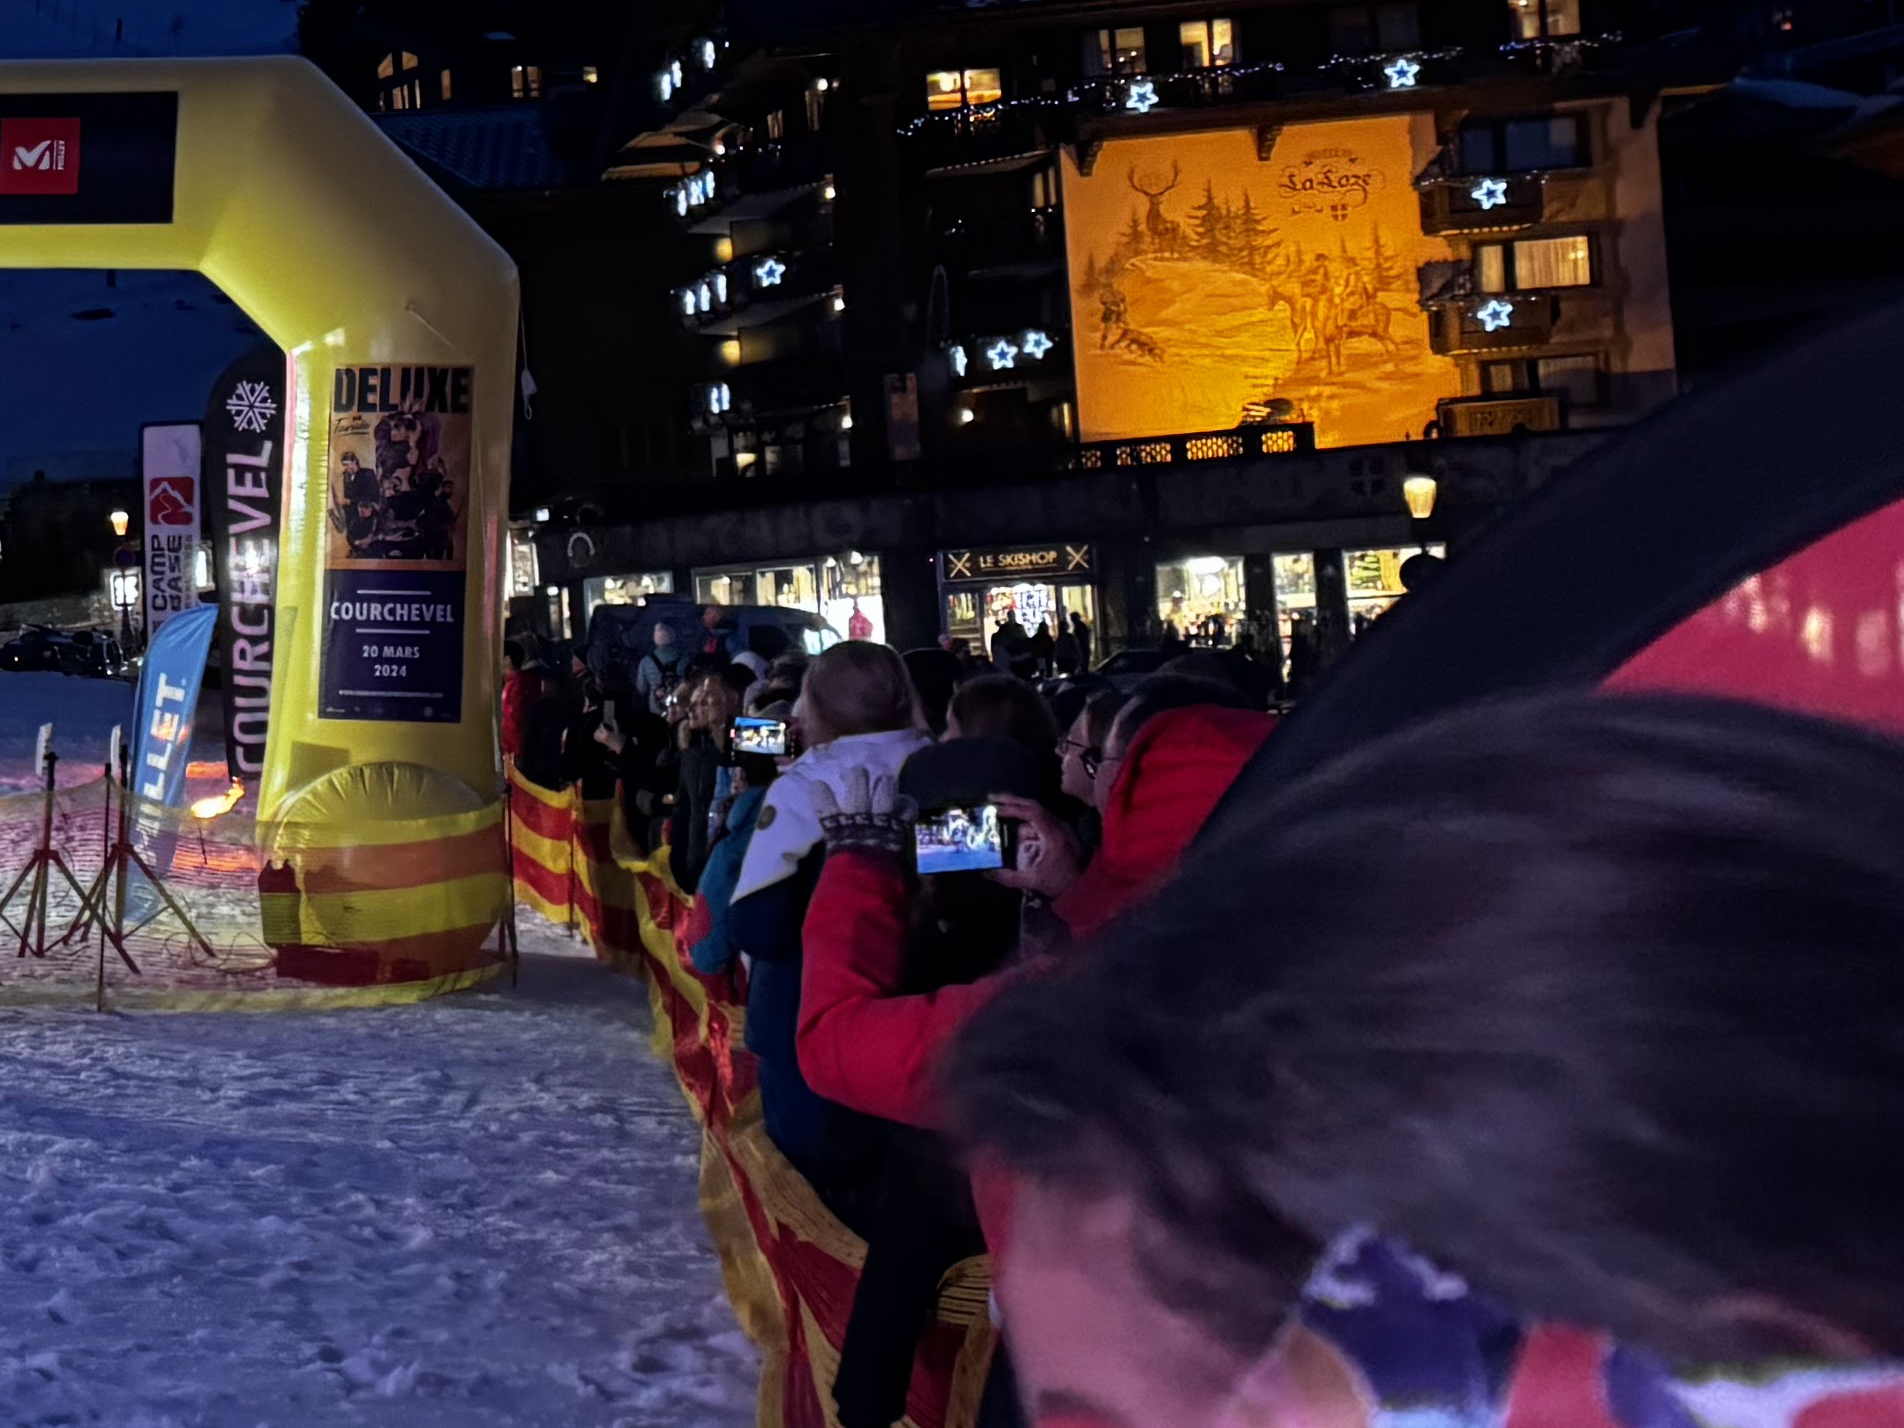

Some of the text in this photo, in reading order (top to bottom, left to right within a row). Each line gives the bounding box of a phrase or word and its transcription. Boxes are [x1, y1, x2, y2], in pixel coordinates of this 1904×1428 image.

[332, 367, 475, 415] DELUXE
[978, 550, 1059, 569] LE SKISHOP
[150, 533, 167, 612] CAMP
[224, 438, 274, 775] COURCHEVEL
[330, 601, 455, 623] COURCHEVEL
[362, 644, 421, 659] 20 MARS
[373, 664, 408, 678] 2024
